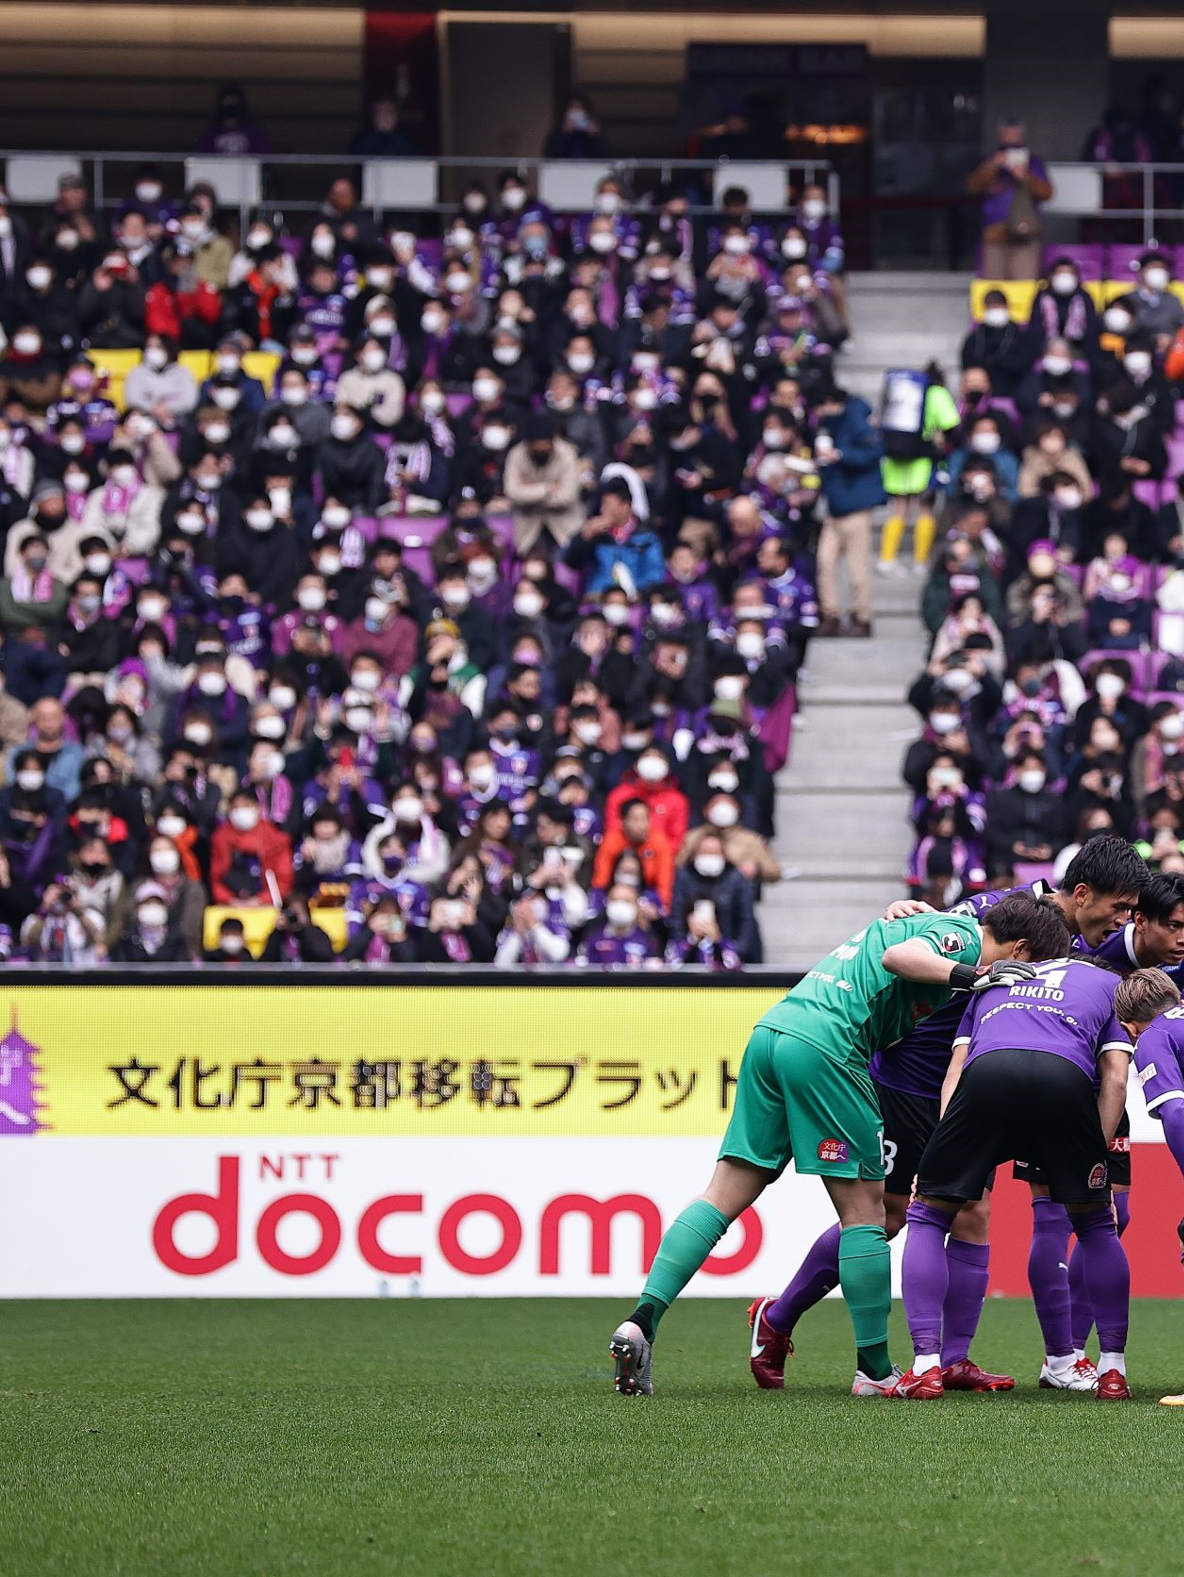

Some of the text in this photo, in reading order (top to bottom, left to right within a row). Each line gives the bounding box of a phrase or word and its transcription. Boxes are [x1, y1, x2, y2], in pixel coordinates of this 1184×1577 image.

[1008, 985, 1065, 1002] RIKITO
[980, 1002, 1034, 1025] RESPECT
[820, 1151, 846, 1161] 京都へ
[823, 1142, 847, 1153] 文化庁
[260, 1154, 341, 1180] NTT
